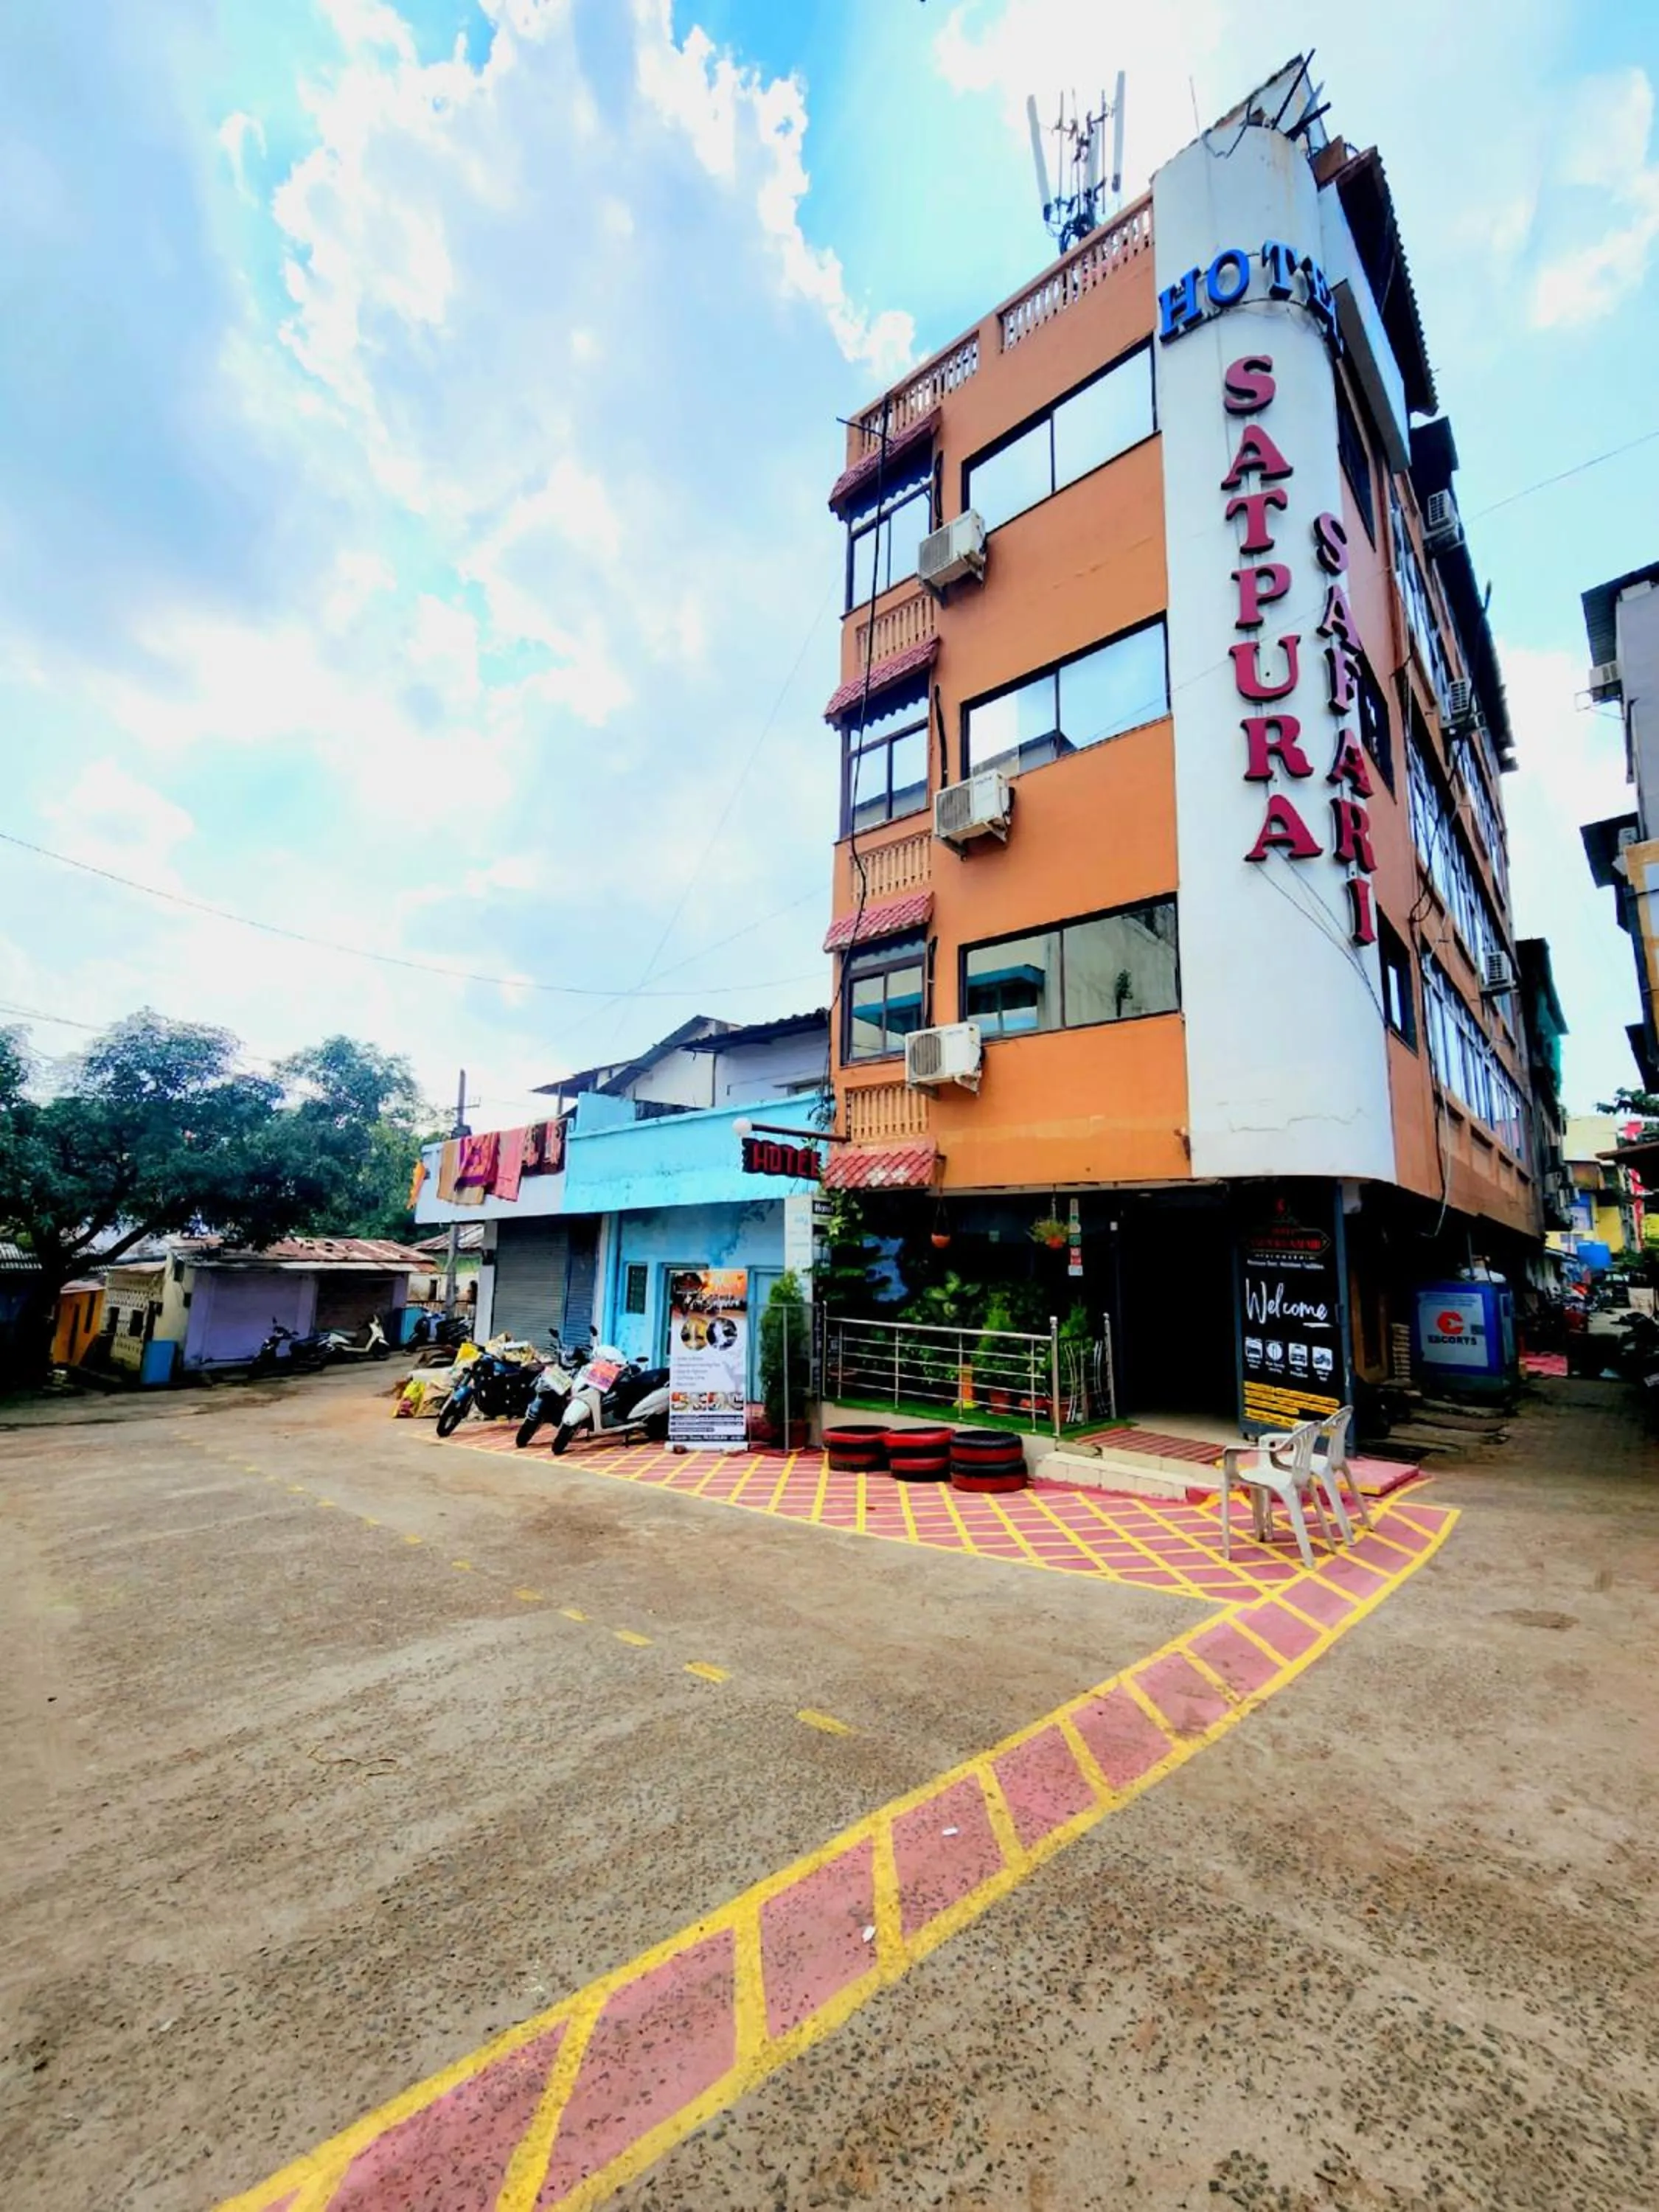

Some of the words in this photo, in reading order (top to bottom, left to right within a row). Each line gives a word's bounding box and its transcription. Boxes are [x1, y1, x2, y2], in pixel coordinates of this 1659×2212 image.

[1221, 355, 1322, 863] SATPURA
[1313, 512, 1376, 947] SAFARI
[753, 1142, 821, 1178] HOTEL
[1245, 1278, 1328, 1324] Welcome
